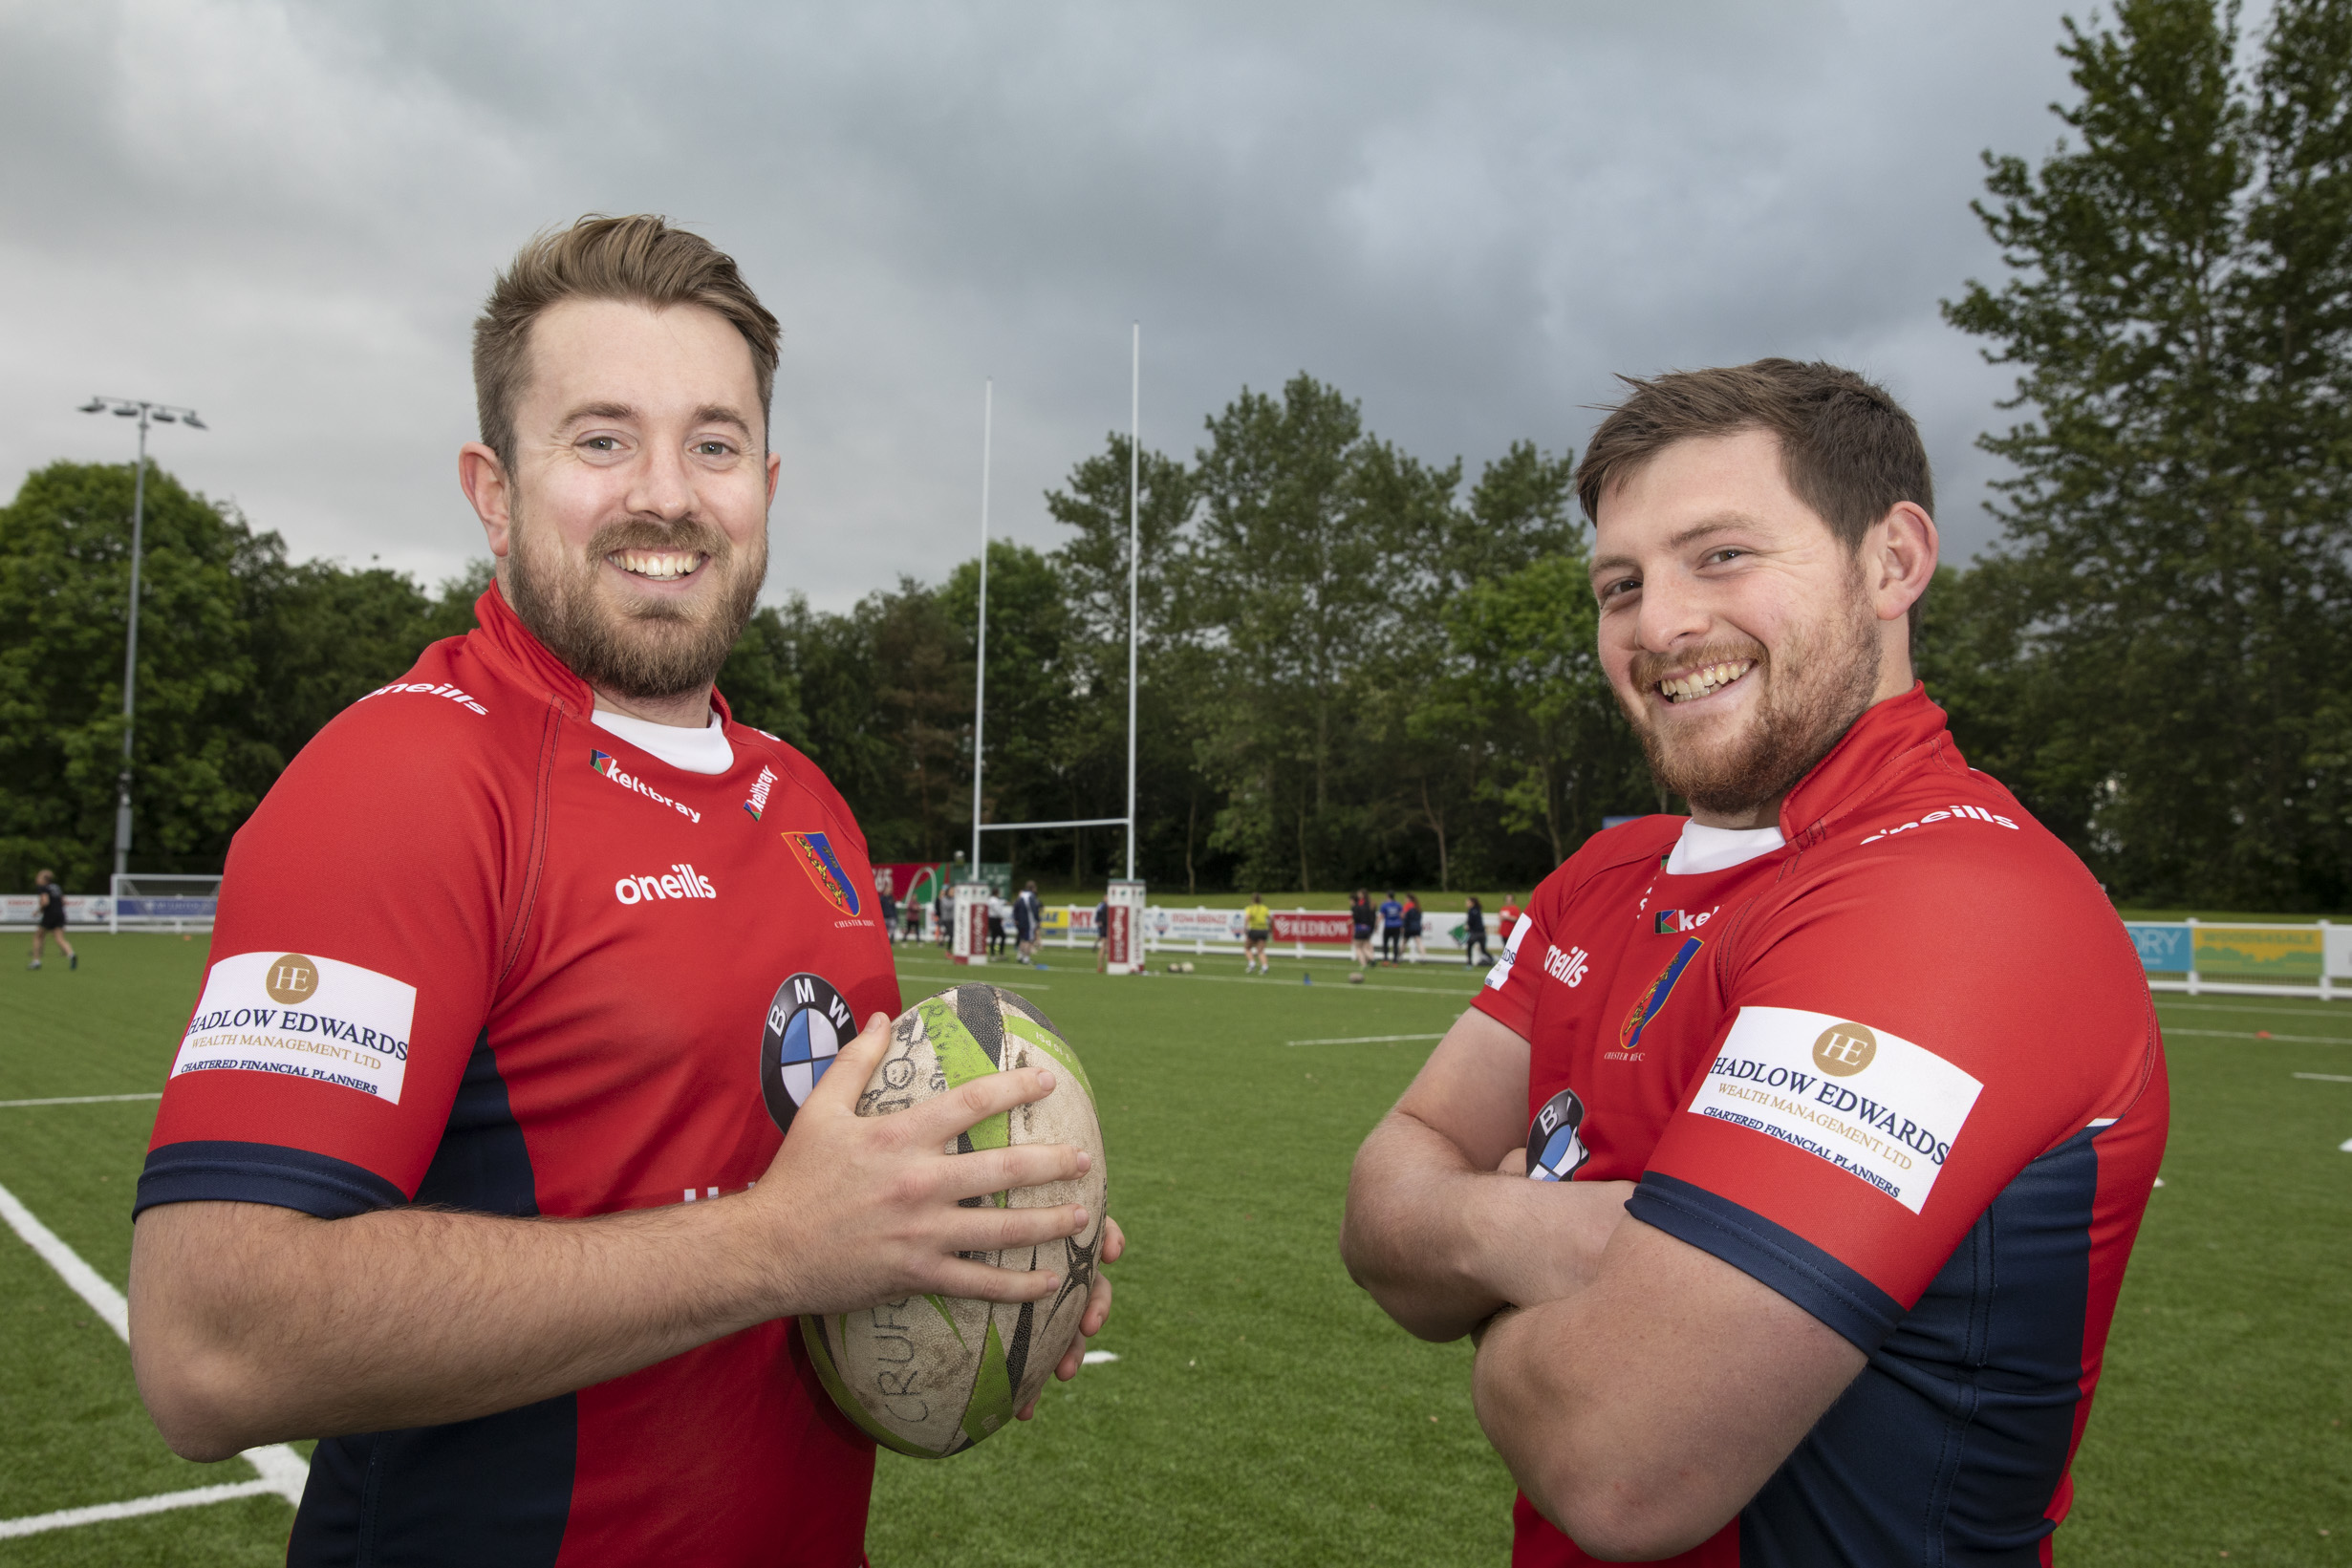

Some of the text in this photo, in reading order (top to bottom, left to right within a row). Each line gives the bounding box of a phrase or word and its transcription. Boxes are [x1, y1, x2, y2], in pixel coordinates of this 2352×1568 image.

[606, 758, 701, 824] keltbray
[746, 764, 778, 812] keltbray
[615, 863, 717, 905] o'neills
[1291, 919, 1349, 937] REDROW
[274, 966, 311, 993] HE
[767, 977, 851, 1038] BMW
[186, 1008, 408, 1062] HADLOW EDWARDS
[191, 1034, 381, 1070] WEALTH MANAGEMENT LTD
[1821, 1031, 1868, 1066] HE
[181, 1059, 378, 1095] CHARTERED FINANCIAL PLANNERS
[1709, 1057, 1951, 1166] HADLOW EDWARDS
[1718, 1083, 1912, 1171] WEALTH MANAGEMENT LTD
[1703, 1106, 1901, 1198] CHARTERED FINANCIAL PLANNERS
